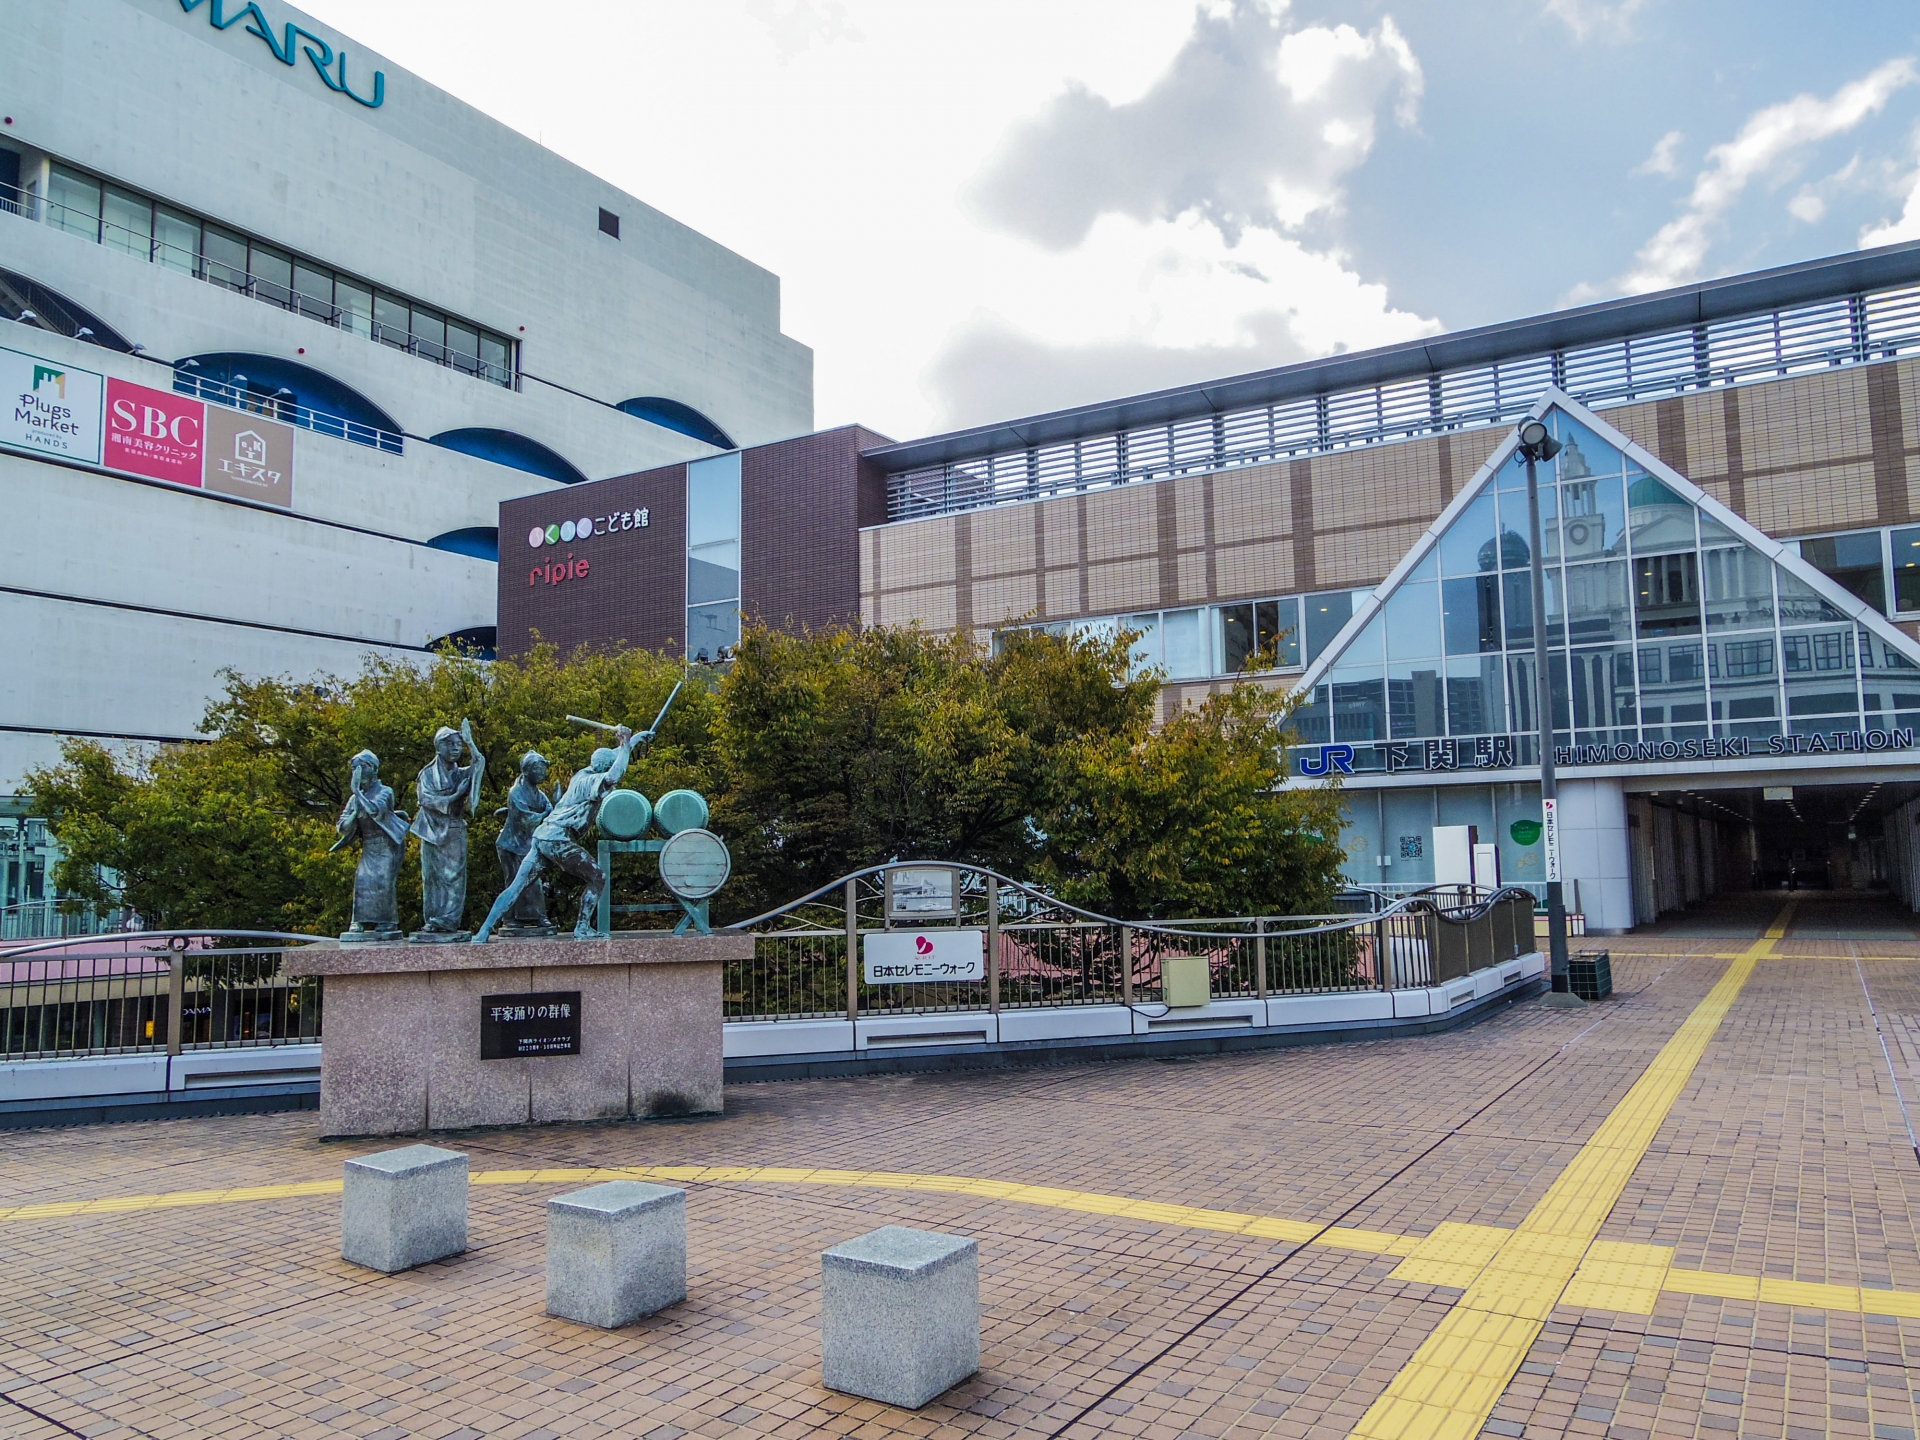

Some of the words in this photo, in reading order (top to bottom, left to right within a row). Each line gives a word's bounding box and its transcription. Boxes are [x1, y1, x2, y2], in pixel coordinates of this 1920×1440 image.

[19, 393, 71, 420] Plugs
[15, 407, 79, 436] Market
[112, 399, 198, 449] SBC
[25, 433, 68, 450] HANDS
[218, 458, 281, 485] エキスタ
[529, 552, 590, 587] ripie
[1300, 744, 1355, 776] JR
[1373, 736, 1514, 773] 下関駅
[1539, 735, 1750, 766] HIMONOSEKI
[1769, 727, 1914, 755] STATION
[873, 961, 975, 978] 日本セレモニーウォーク
[490, 1003, 572, 1022] 平家踊りの群像
